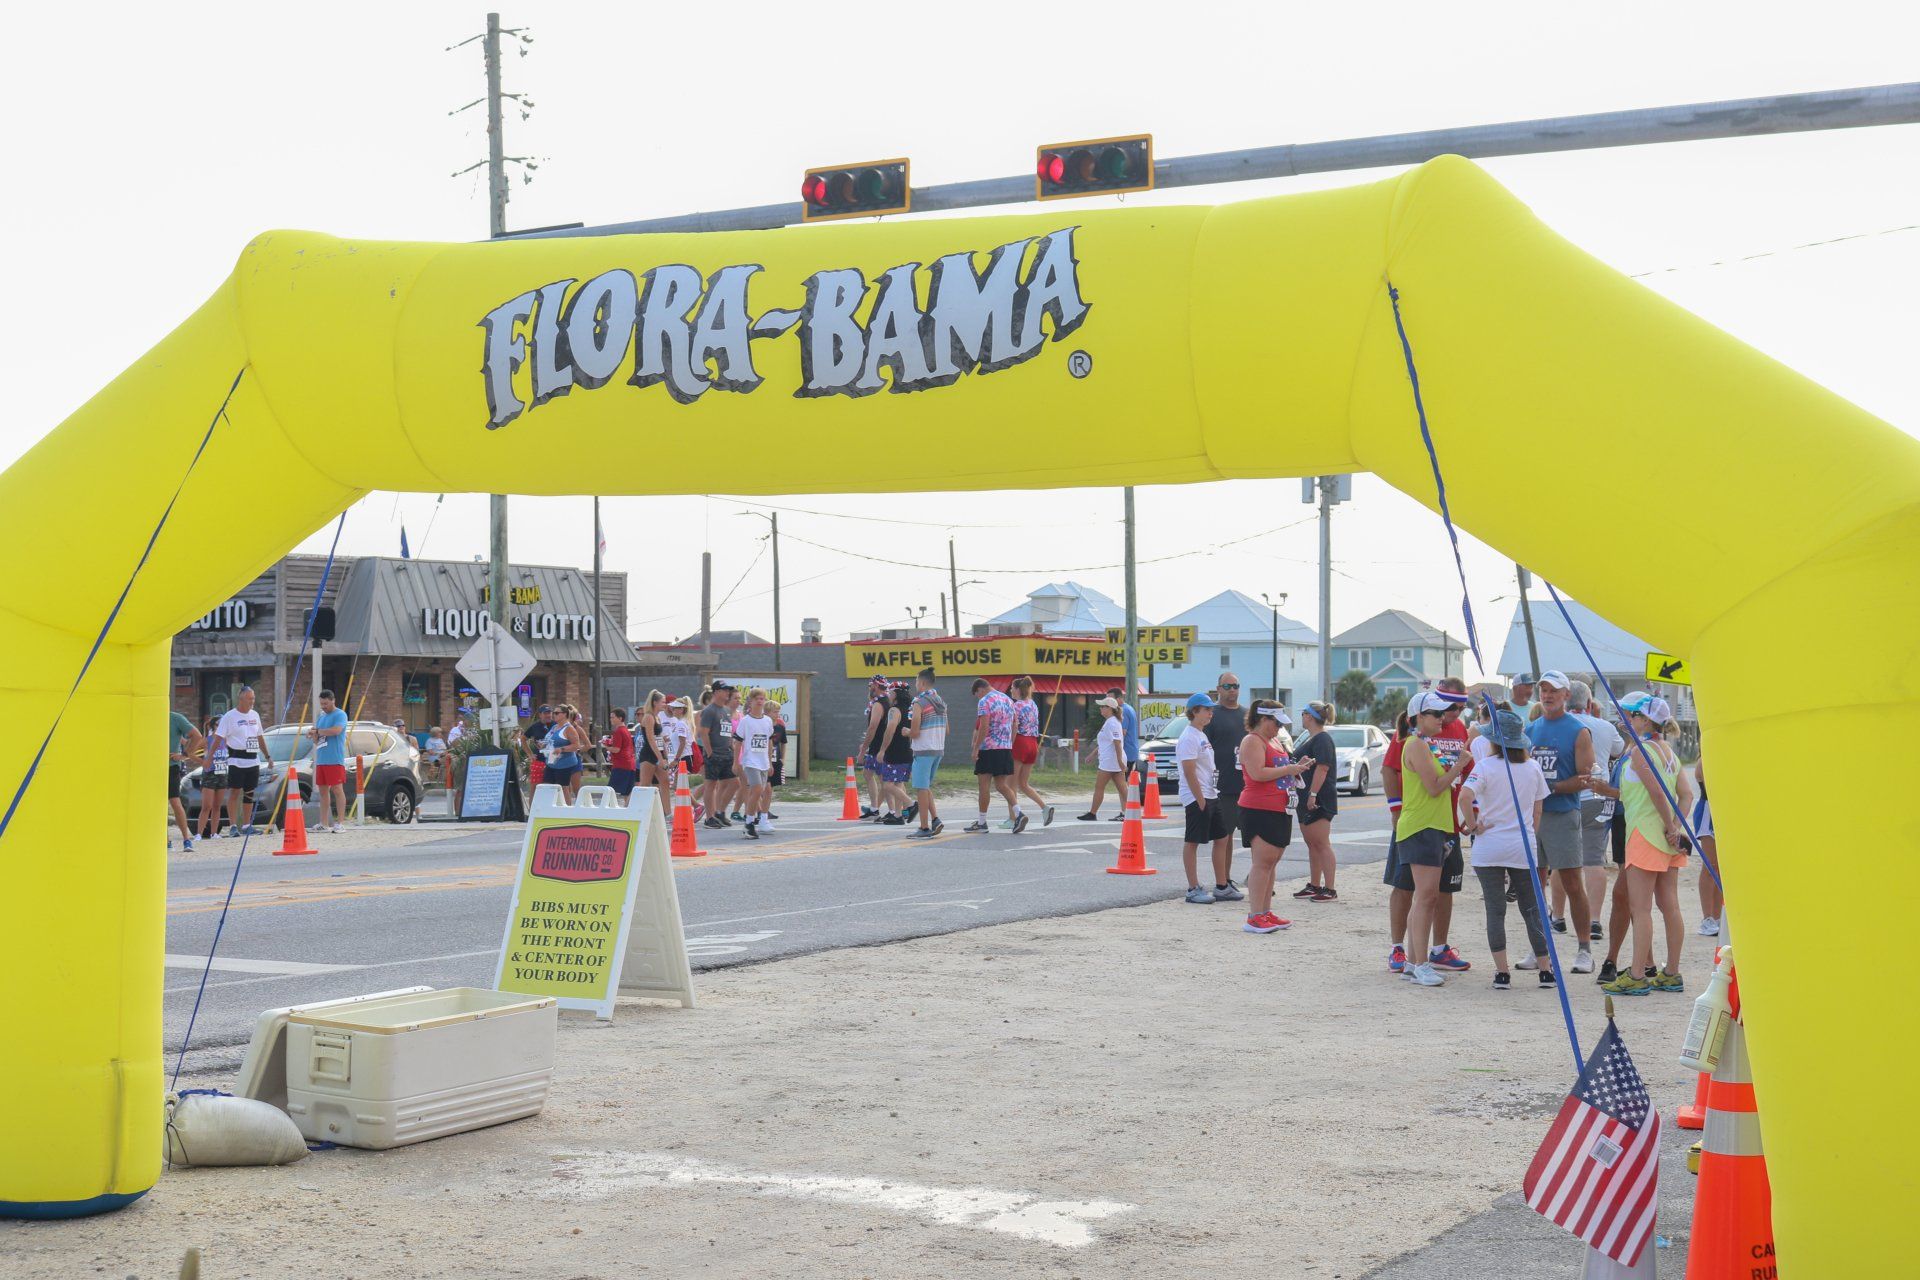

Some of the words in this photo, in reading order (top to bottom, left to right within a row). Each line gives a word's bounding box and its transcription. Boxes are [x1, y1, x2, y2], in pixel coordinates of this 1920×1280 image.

[477, 226, 1093, 430] FLORA-BAMA
[190, 600, 247, 629] OTTO
[423, 608, 491, 639] LIQUO
[513, 616, 526, 632] &
[530, 613, 596, 641] LOTTO
[1108, 628, 1190, 643] WFFLE
[863, 651, 933, 667] WAFFLE
[943, 648, 1001, 664] HOUSE
[1035, 648, 1090, 665] WAFFLE
[1114, 648, 1184, 661] HUSE
[1532, 756, 1557, 770] 037
[546, 836, 616, 852] INTERNATIONAL
[542, 852, 599, 872] RUNNING
[531, 901, 564, 913] BIBS
[567, 903, 609, 915] MUST
[521, 917, 540, 929] BE
[542, 918, 587, 931] WORN
[590, 921, 612, 932] ON
[522, 934, 551, 946] THE
[554, 936, 605, 949] FRONT
[511, 952, 522, 962] &
[525, 951, 584, 965] CENTER
[587, 955, 607, 966] OF
[515, 968, 554, 981] YOUR
[557, 970, 599, 983] BODY
